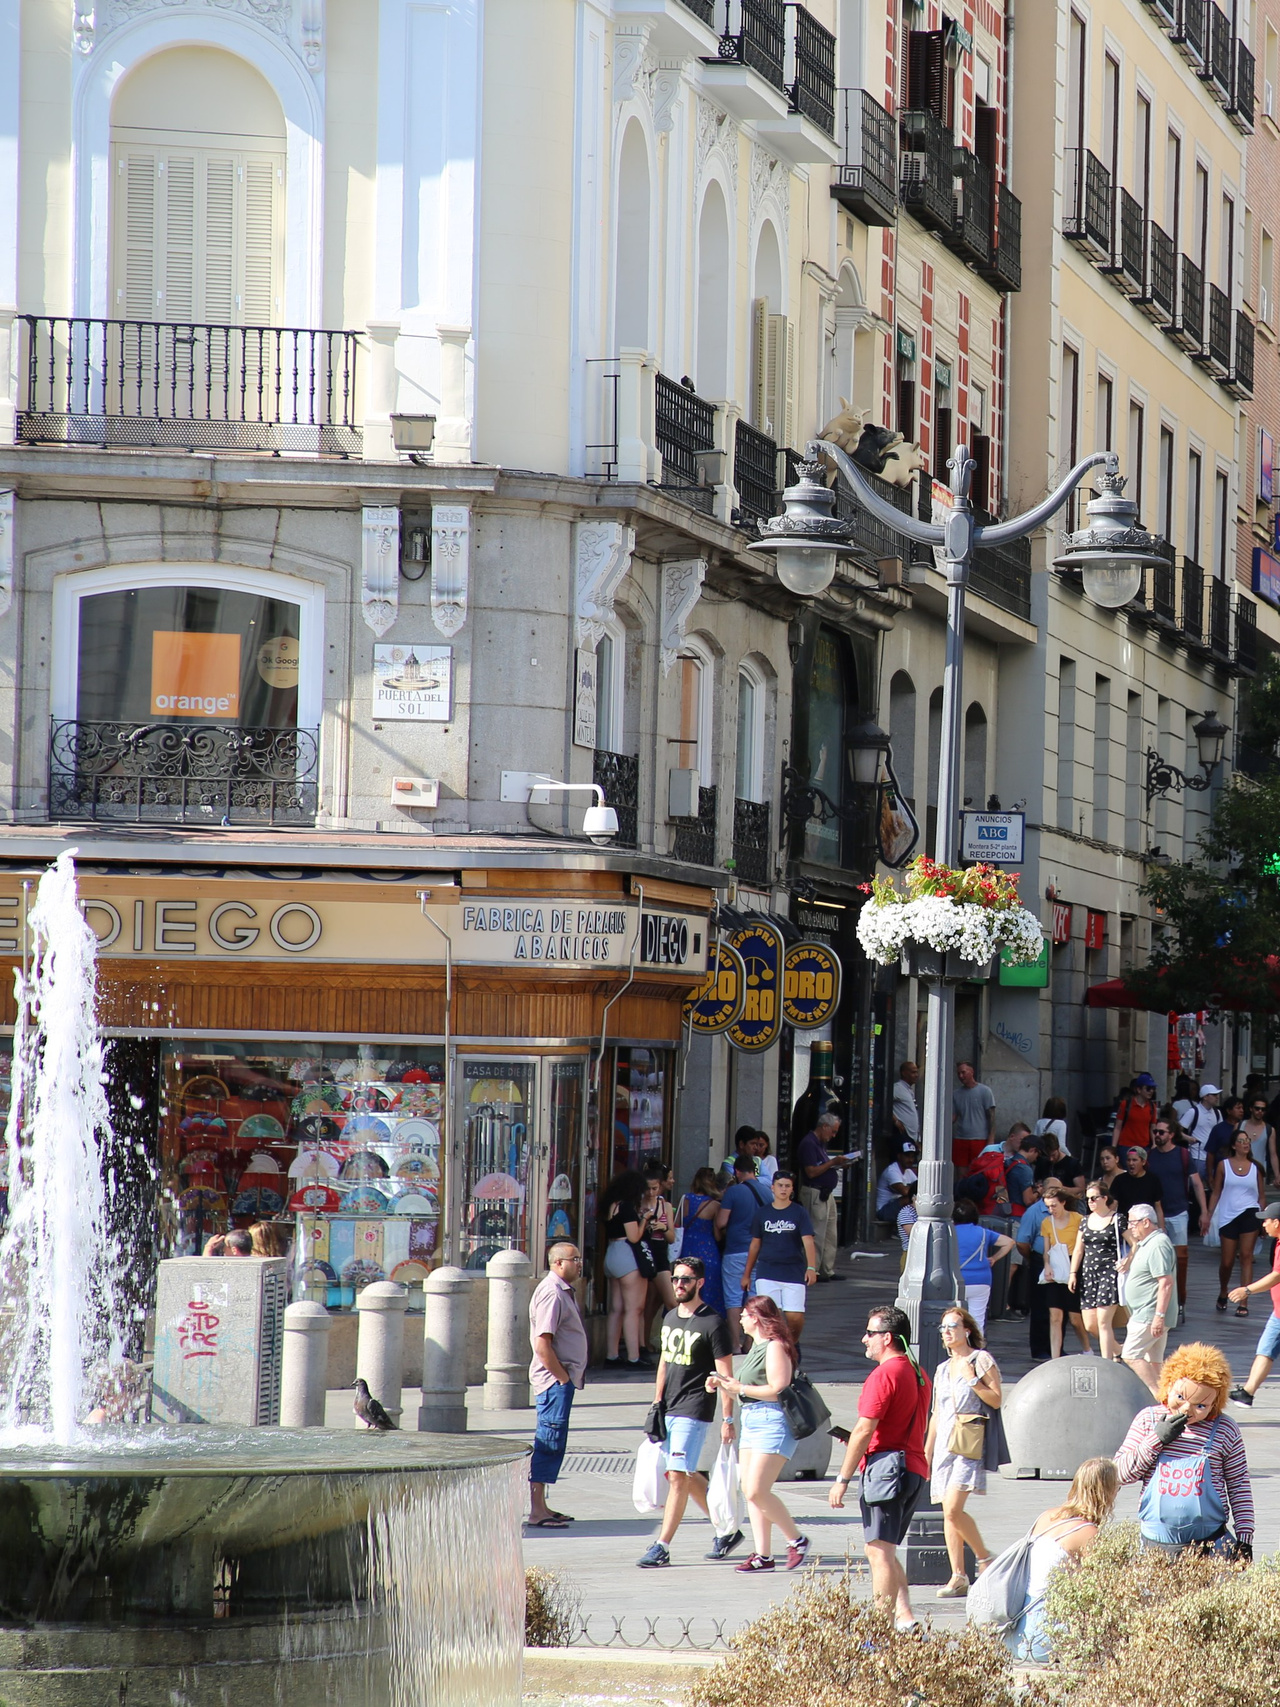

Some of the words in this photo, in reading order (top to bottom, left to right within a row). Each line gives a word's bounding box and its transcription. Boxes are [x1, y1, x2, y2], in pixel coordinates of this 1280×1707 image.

[262, 656, 274, 664] Ok
[155, 693, 230, 715] orange
[378, 689, 423, 702] PUERTA
[424, 693, 444, 703] DEL
[398, 702, 425, 716] SOL
[975, 815, 1013, 824] ANUNCIOS
[979, 827, 1007, 839] ABC
[968, 842, 990, 850] Montera
[1000, 844, 1018, 852] planta
[969, 850, 1016, 860] RECEPCION
[77, 899, 323, 952] DIEGO
[463, 906, 545, 932] FABRICA
[551, 909, 573, 933] DE
[577, 910, 627, 935] PARAGUAS
[1052, 903, 1070, 942] KFC
[514, 935, 610, 961] ABANICOS
[641, 914, 689, 965] DIEGO
[732, 927, 776, 949] COMPRO
[786, 949, 831, 970] COMPRO
[784, 970, 833, 1001] ORO
[739, 988, 775, 1022] RO
[783, 999, 830, 1022] EMPEÑO
[730, 1024, 773, 1045] EMPEÑO
[466, 1065, 492, 1076] CASA
[493, 1066, 506, 1077] DE
[660, 1325, 702, 1357] BOY
[1158, 1478, 1205, 1498] GUYS
